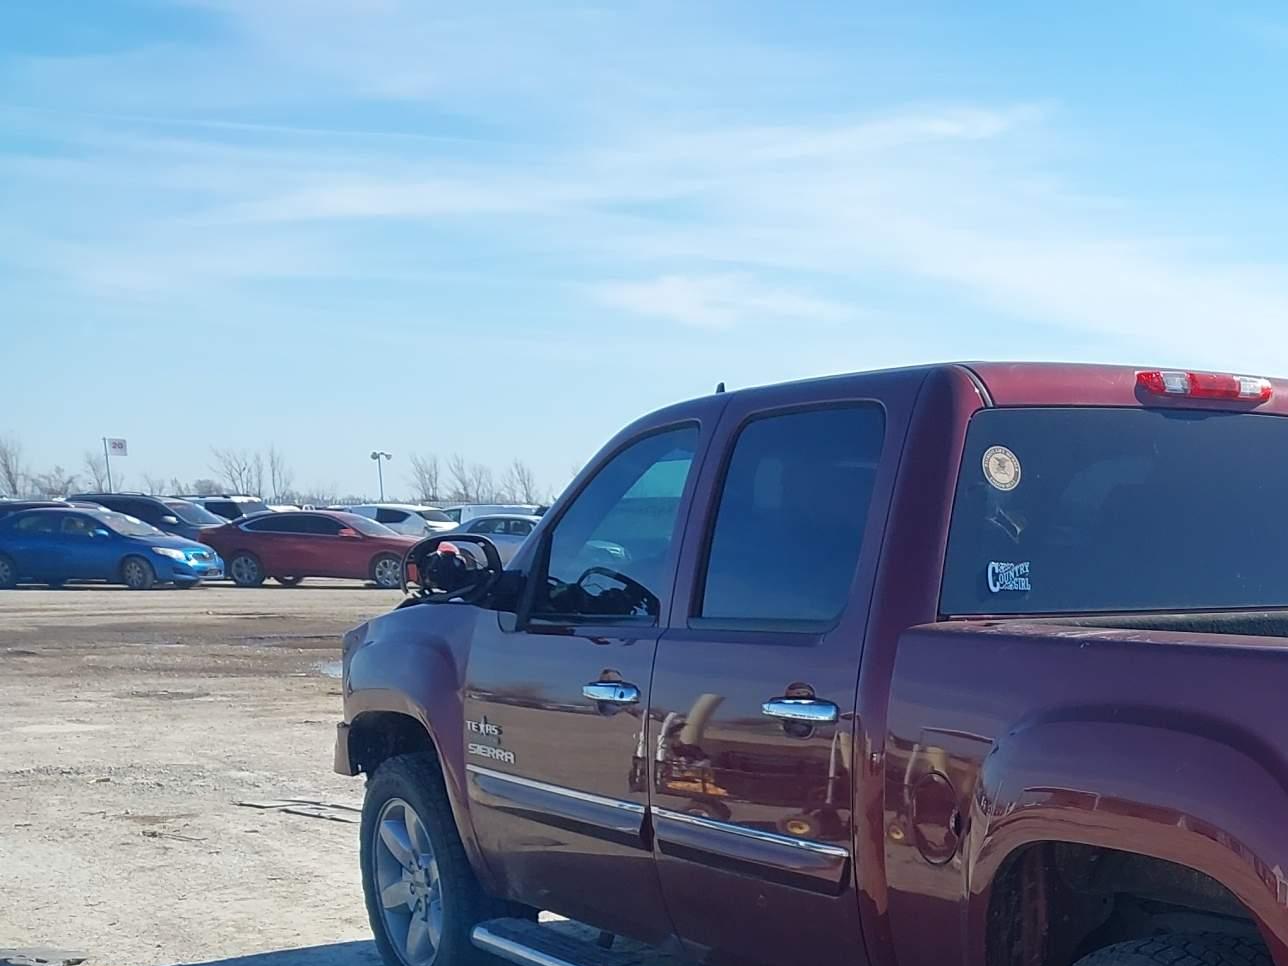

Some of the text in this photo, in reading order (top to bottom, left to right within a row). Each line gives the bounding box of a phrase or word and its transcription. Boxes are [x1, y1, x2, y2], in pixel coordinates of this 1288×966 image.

[988, 561, 1030, 592] COUNTRY
[1014, 577, 1031, 590] GIRL
[465, 715, 498, 736] TEXAS
[468, 743, 515, 764] SIERRA
